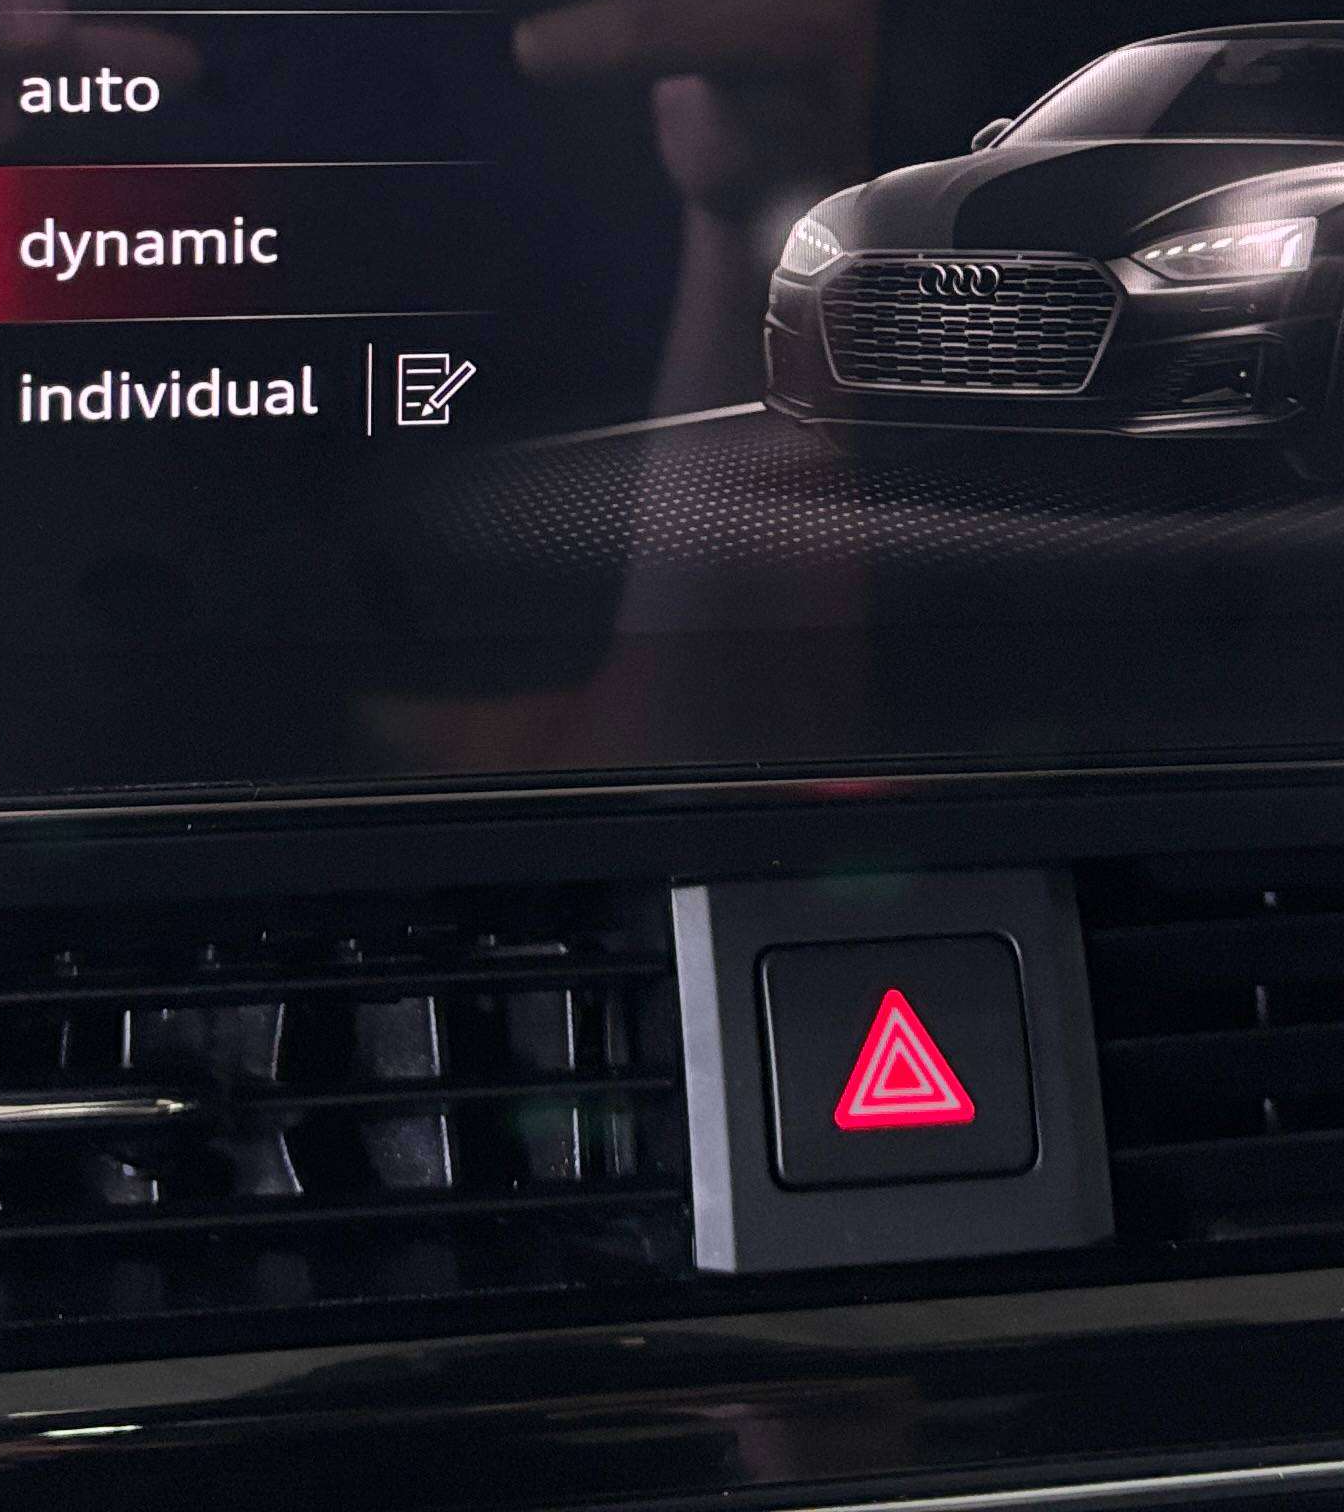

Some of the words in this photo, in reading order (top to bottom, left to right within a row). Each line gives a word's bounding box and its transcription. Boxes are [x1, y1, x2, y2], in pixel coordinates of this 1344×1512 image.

[19, 66, 161, 114] auto
[18, 216, 279, 283] dynamic
[20, 365, 319, 424] individual
